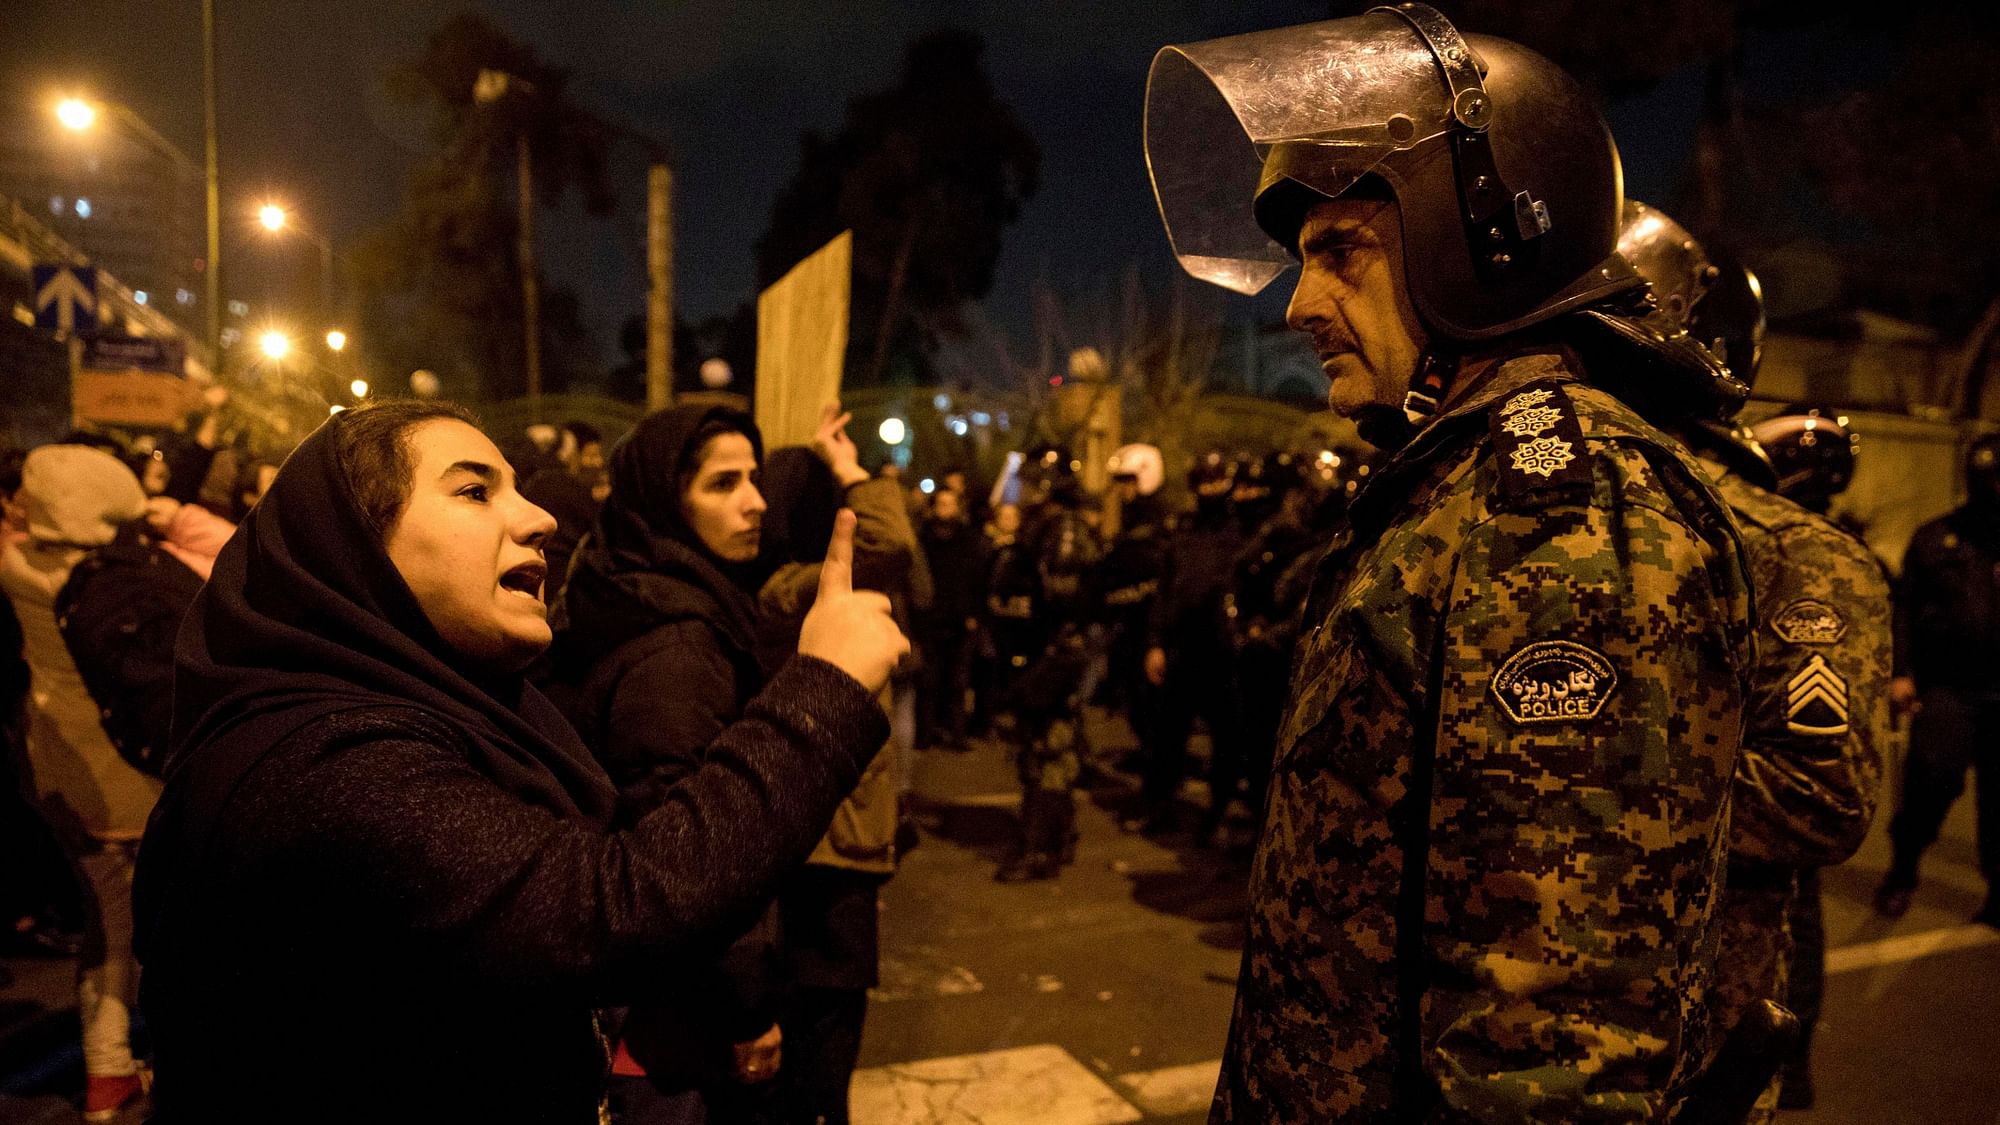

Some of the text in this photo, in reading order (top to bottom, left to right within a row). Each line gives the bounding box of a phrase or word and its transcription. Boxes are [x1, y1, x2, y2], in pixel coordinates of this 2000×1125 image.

[1512, 670, 1597, 702] یگان ویژه
[1520, 699, 1589, 717] POLICE
